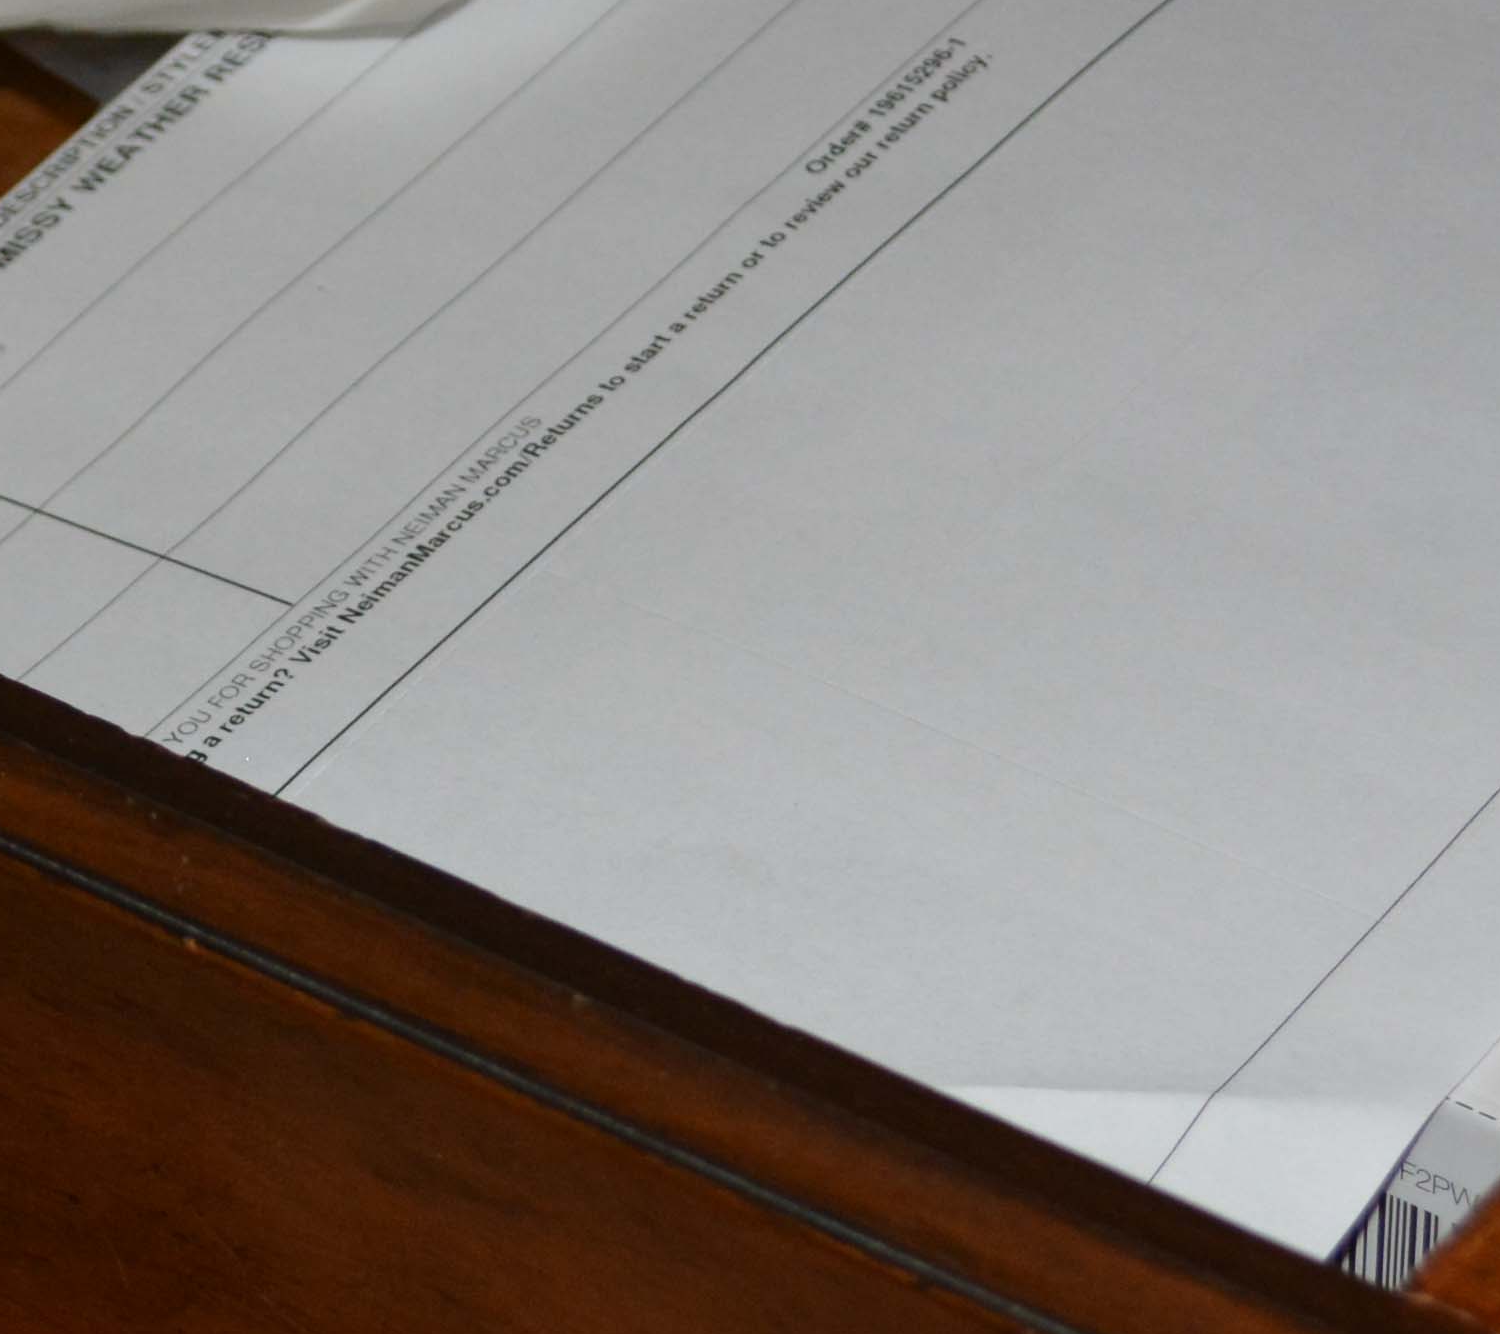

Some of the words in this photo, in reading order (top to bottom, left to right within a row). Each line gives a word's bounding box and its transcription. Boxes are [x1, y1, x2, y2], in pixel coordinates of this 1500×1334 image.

[71, 85, 212, 193] WEATHER
[805, 119, 872, 174] Order#
[204, 735, 222, 748] a
[219, 667, 294, 734] return?
[288, 626, 345, 665] Visit
[337, 393, 604, 625] NeimanMarcus.com/Returns
[599, 374, 627, 391] to
[624, 335, 672, 373] start
[668, 322, 687, 334] a
[683, 270, 744, 320] return
[741, 250, 765, 269] or
[759, 231, 787, 248] to
[784, 179, 846, 230] review
[845, 151, 879, 178] our
[875, 102, 935, 150] return
[930, 53, 994, 102] policy.
[162, 710, 213, 745] YOU
[207, 672, 256, 708] FOR
[249, 588, 351, 672] SHOPPING
[344, 546, 395, 589] WITH
[391, 483, 467, 546] NEIMAN
[459, 415, 543, 485] MARCUS
